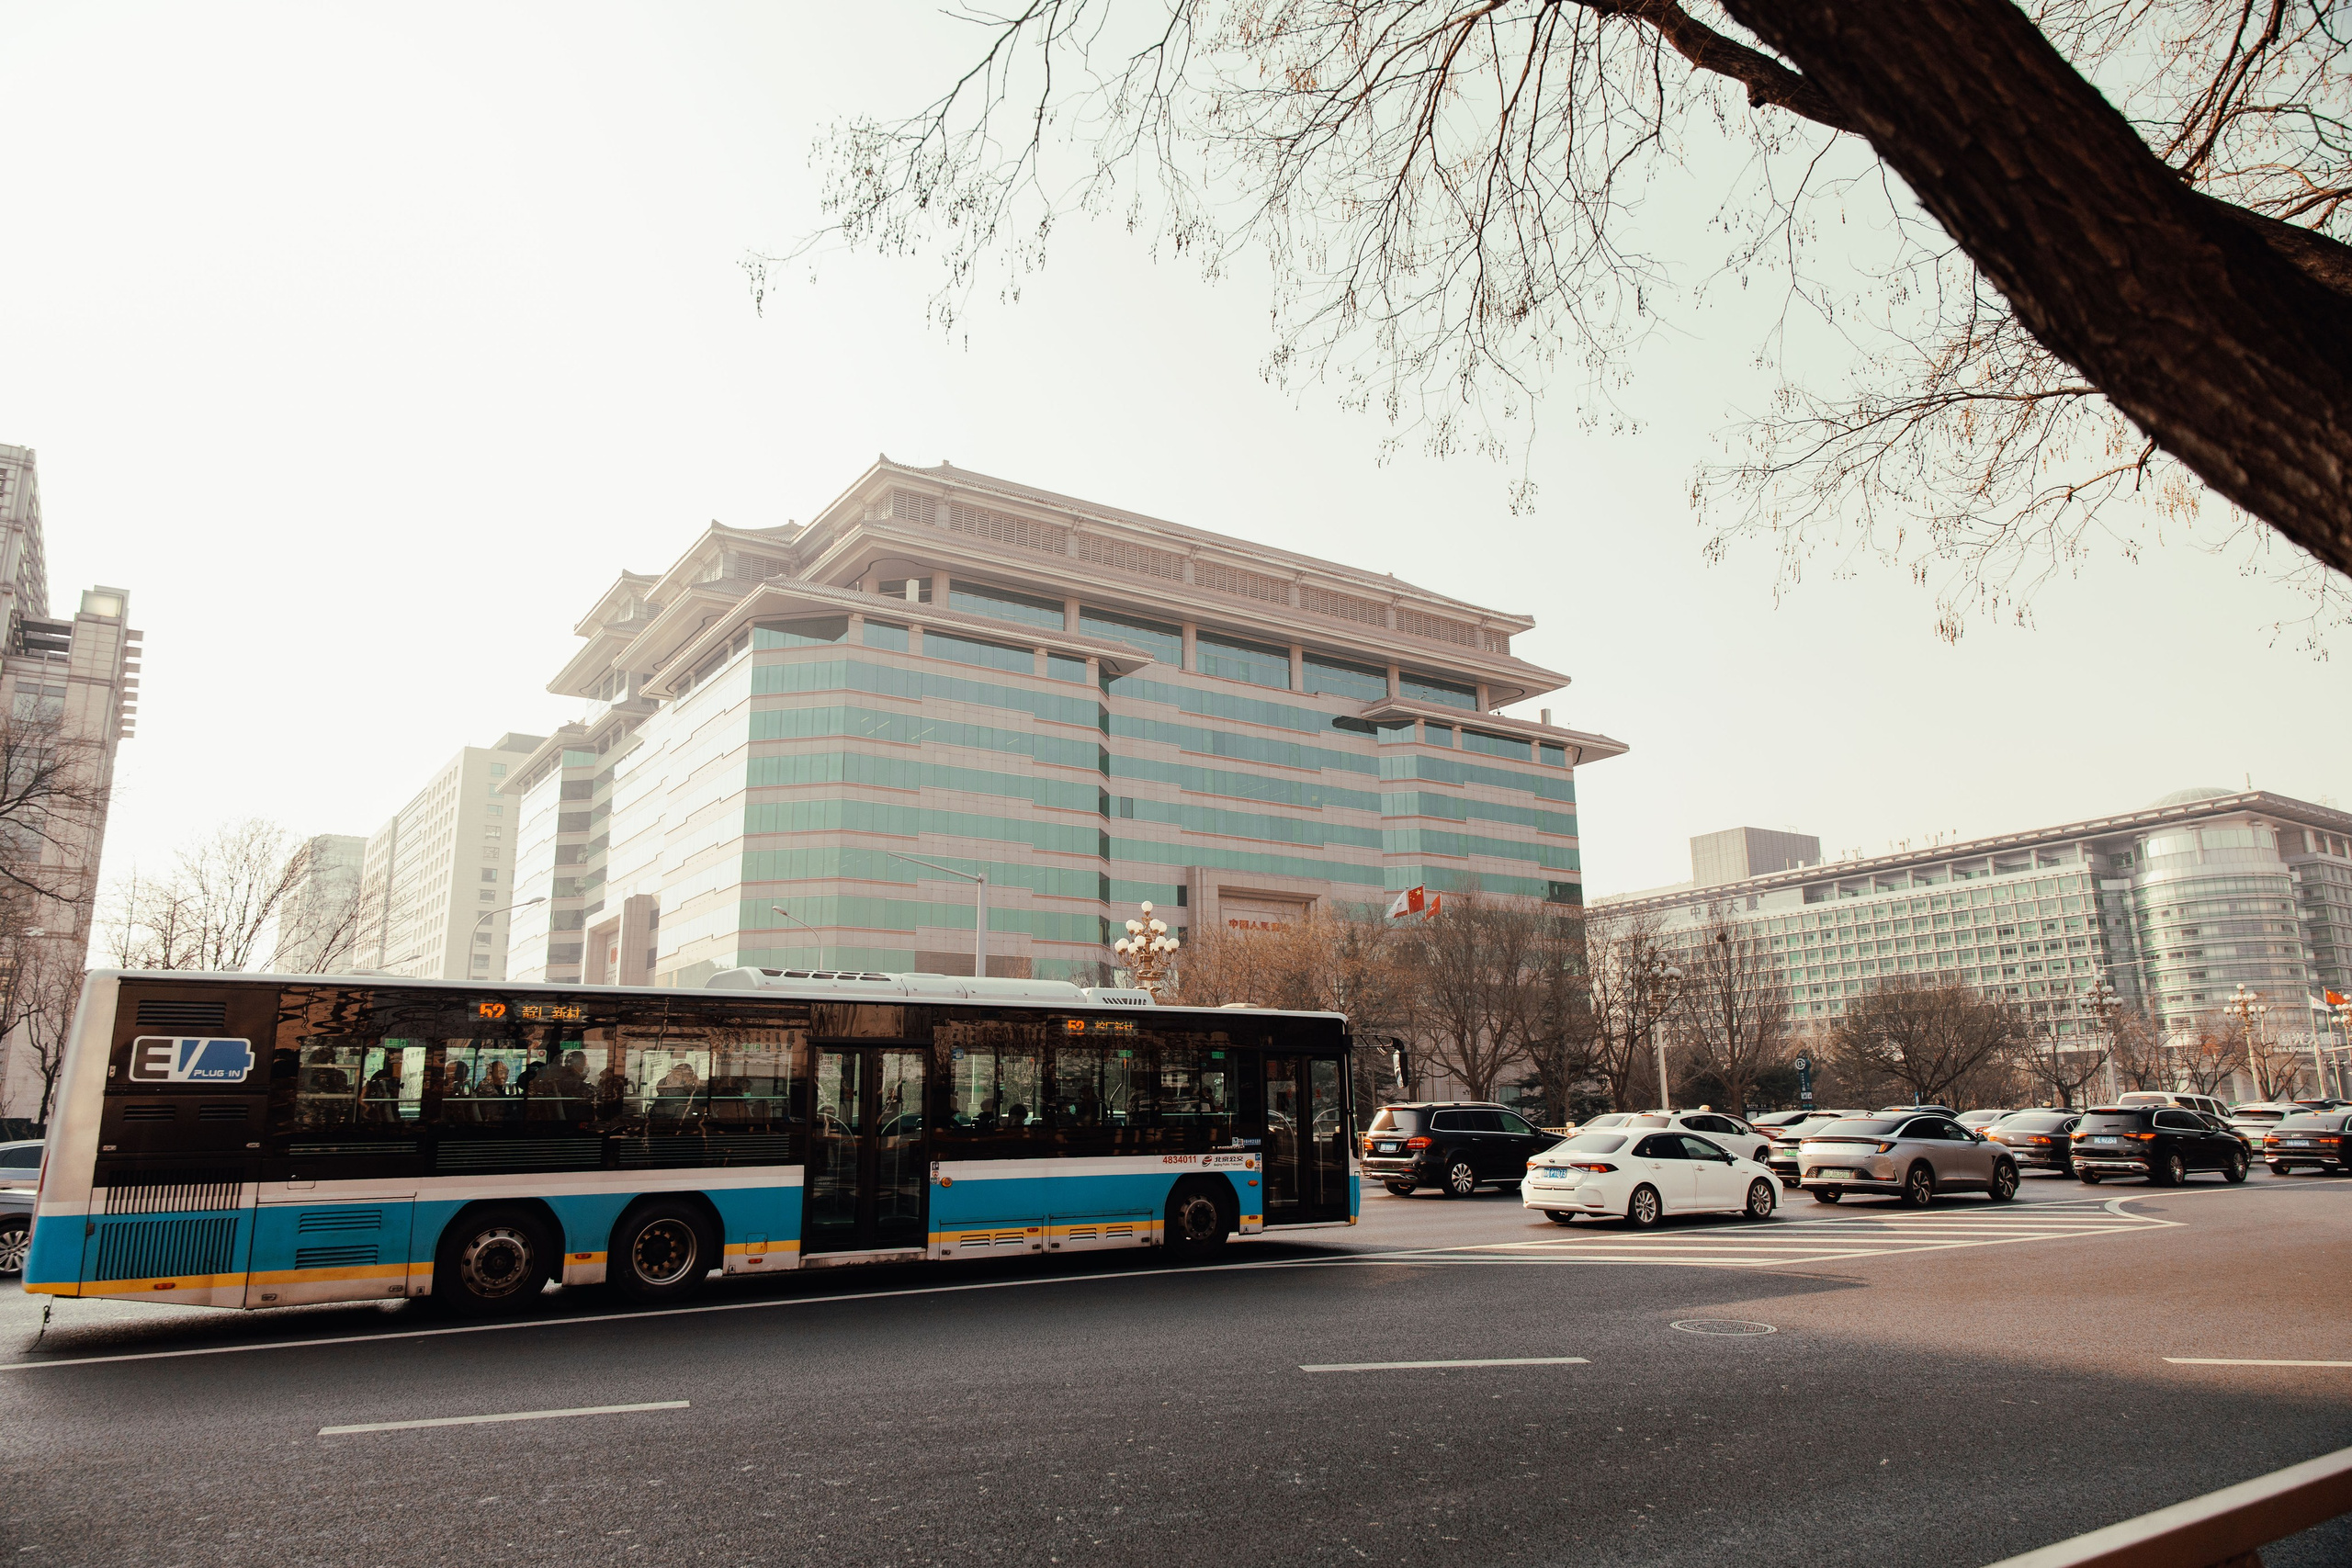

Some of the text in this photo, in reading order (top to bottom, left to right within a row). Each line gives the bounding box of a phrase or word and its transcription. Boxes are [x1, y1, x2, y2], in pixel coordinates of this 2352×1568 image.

[479, 1002, 506, 1019] 52
[1067, 1020, 1085, 1035] 52
[132, 1038, 210, 1080] EV
[193, 1069, 241, 1077] PLUG-IN
[1162, 1155, 1197, 1164] 4834011
